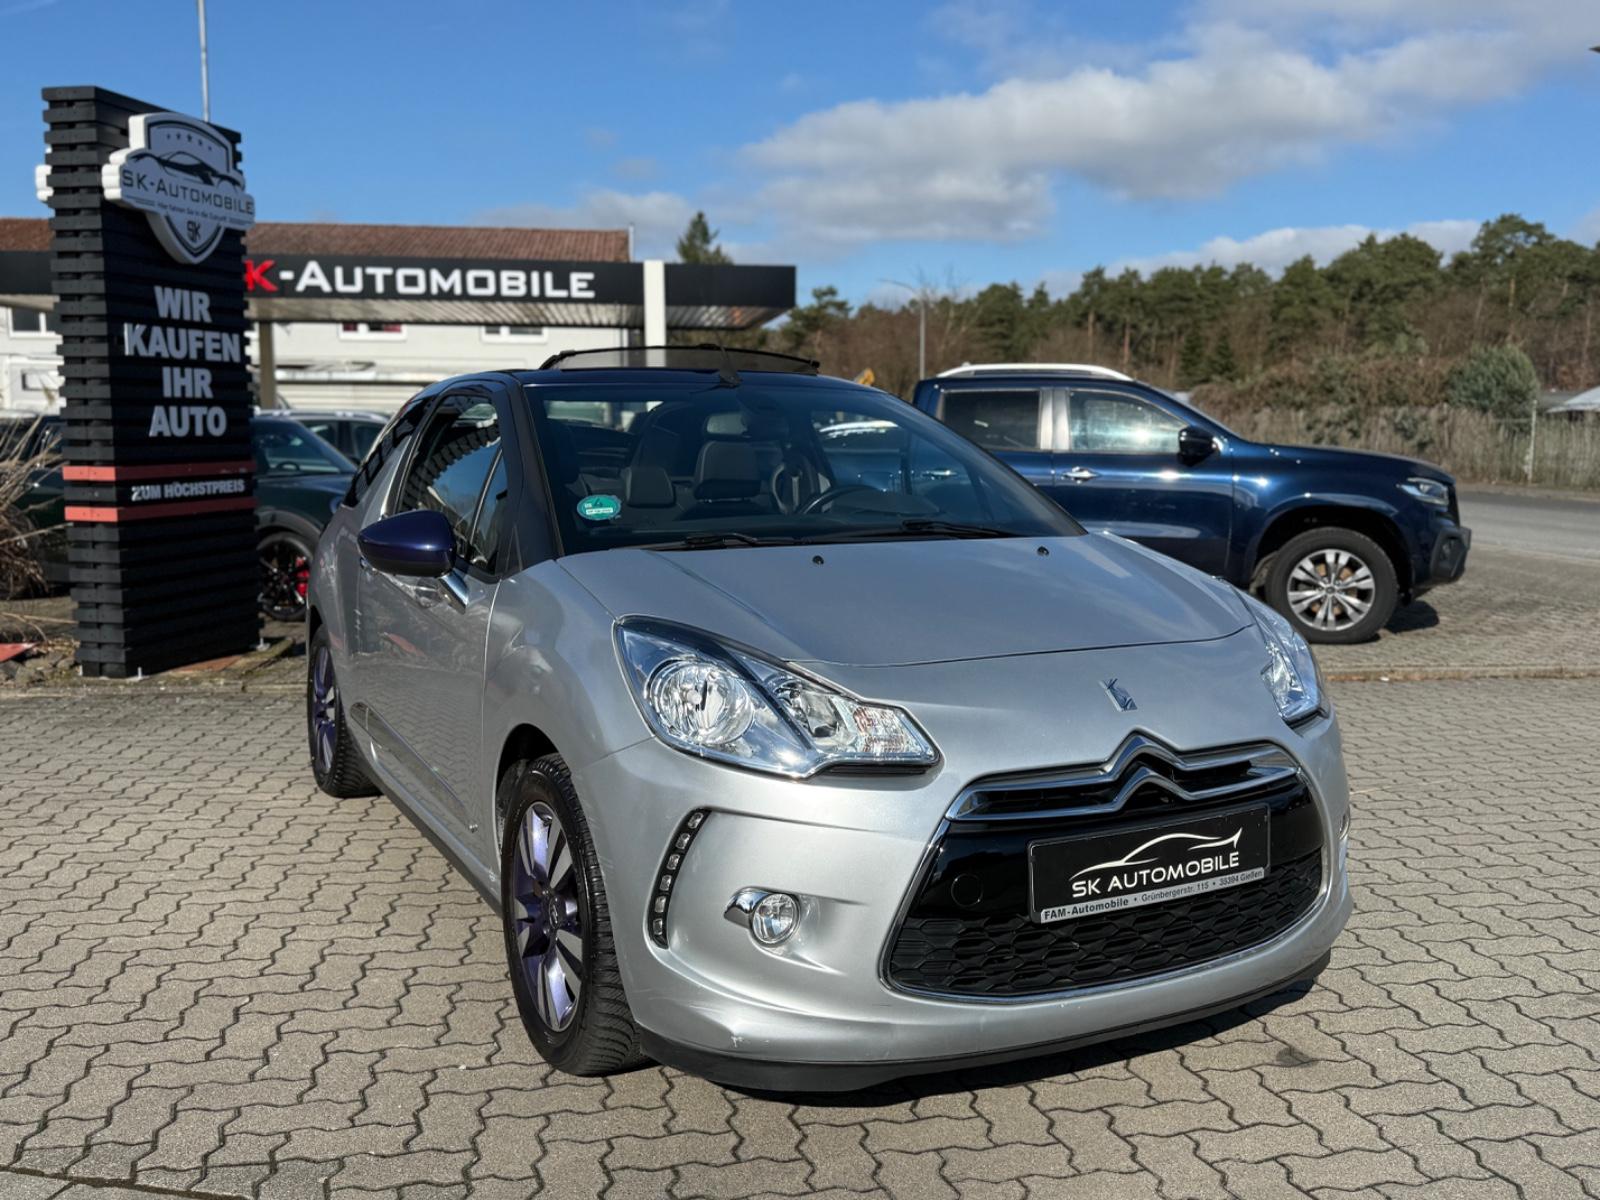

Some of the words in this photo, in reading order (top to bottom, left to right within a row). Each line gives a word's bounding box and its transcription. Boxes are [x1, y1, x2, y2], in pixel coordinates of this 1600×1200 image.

[122, 169, 254, 215] SK-AUTOMOBILE
[243, 258, 595, 299] K-AUTOMOBILE
[153, 285, 213, 323] WIR
[123, 322, 241, 363] KAUFEN
[162, 366, 214, 399] IHR
[148, 405, 227, 438] AUTO
[131, 485, 161, 502] ZUM
[164, 479, 246, 499] HÖCHSTPREIS
[1072, 878, 1101, 898] SK
[1107, 851, 1240, 893] AUTOMOBILE
[1044, 897, 1129, 920] FAM-Automobile
[1197, 881, 1209, 891] 115
